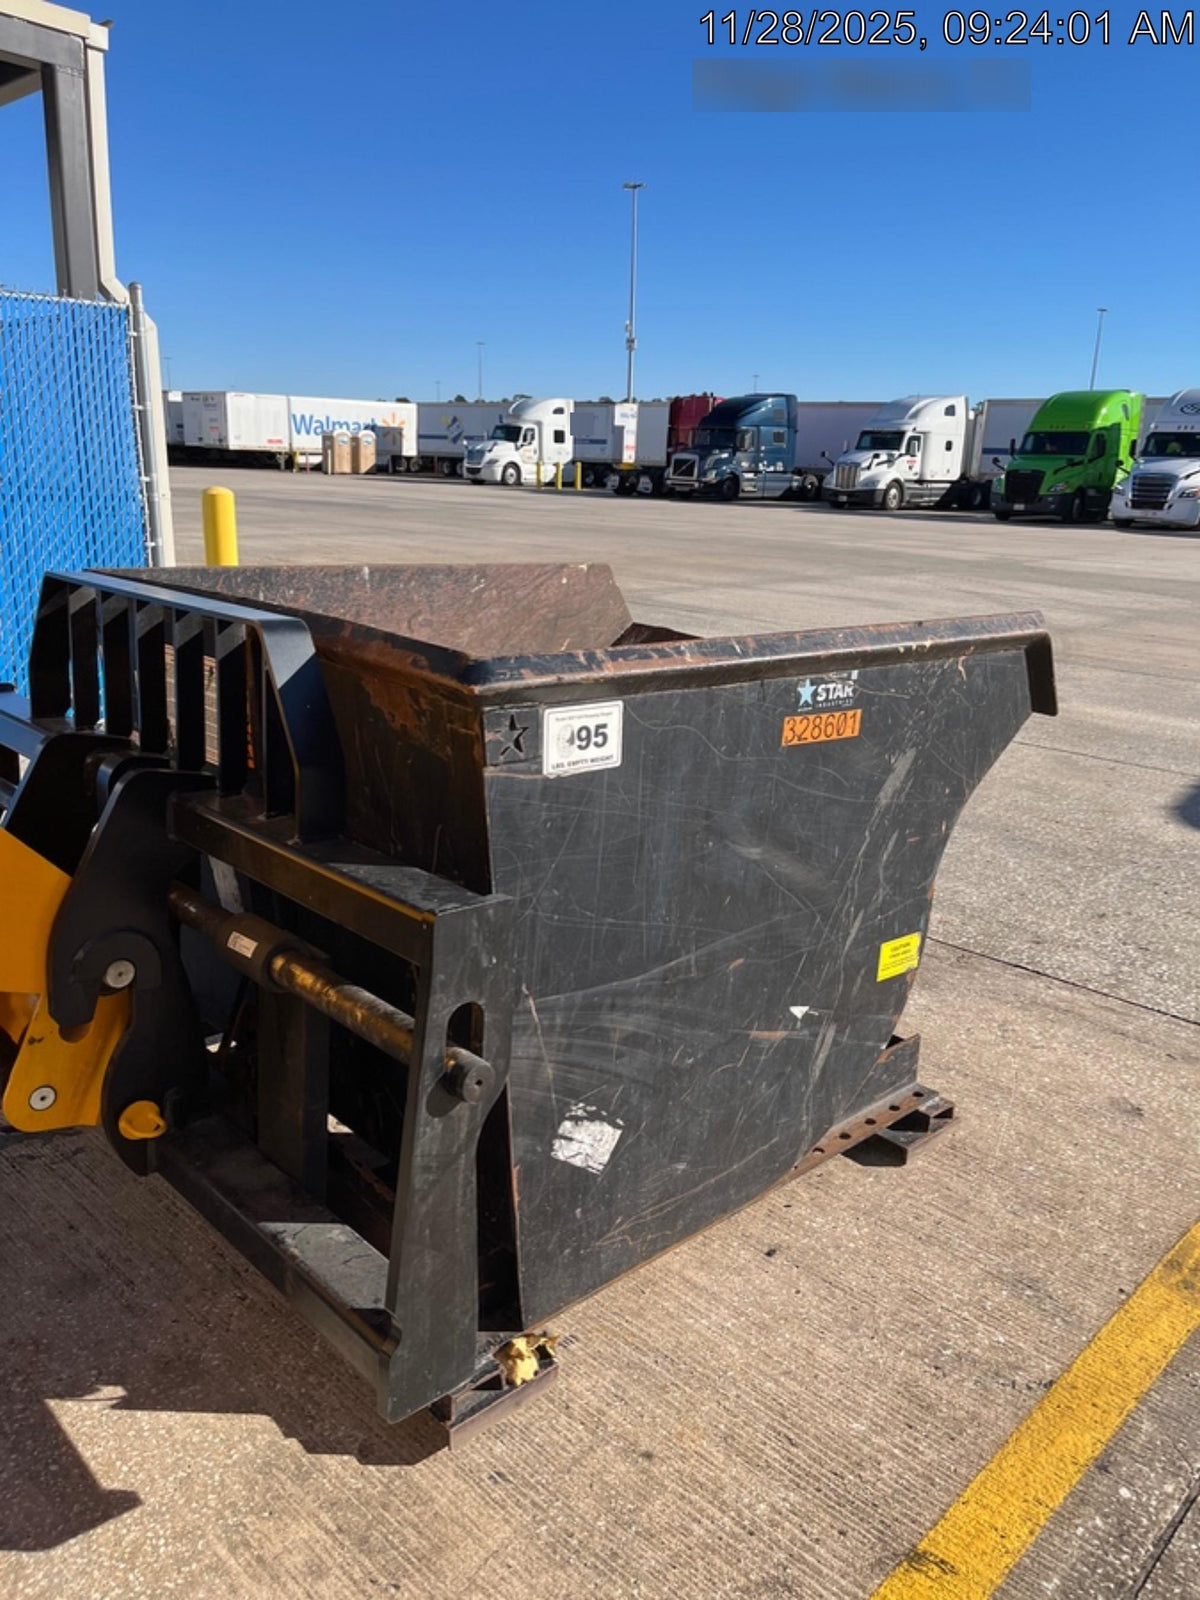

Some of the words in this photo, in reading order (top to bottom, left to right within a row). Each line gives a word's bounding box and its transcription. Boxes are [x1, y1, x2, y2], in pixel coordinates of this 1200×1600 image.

[292, 414, 378, 436] Walmart
[816, 681, 854, 702] STAR
[784, 711, 857, 744] 328601
[590, 754, 614, 763] WEIGHT
